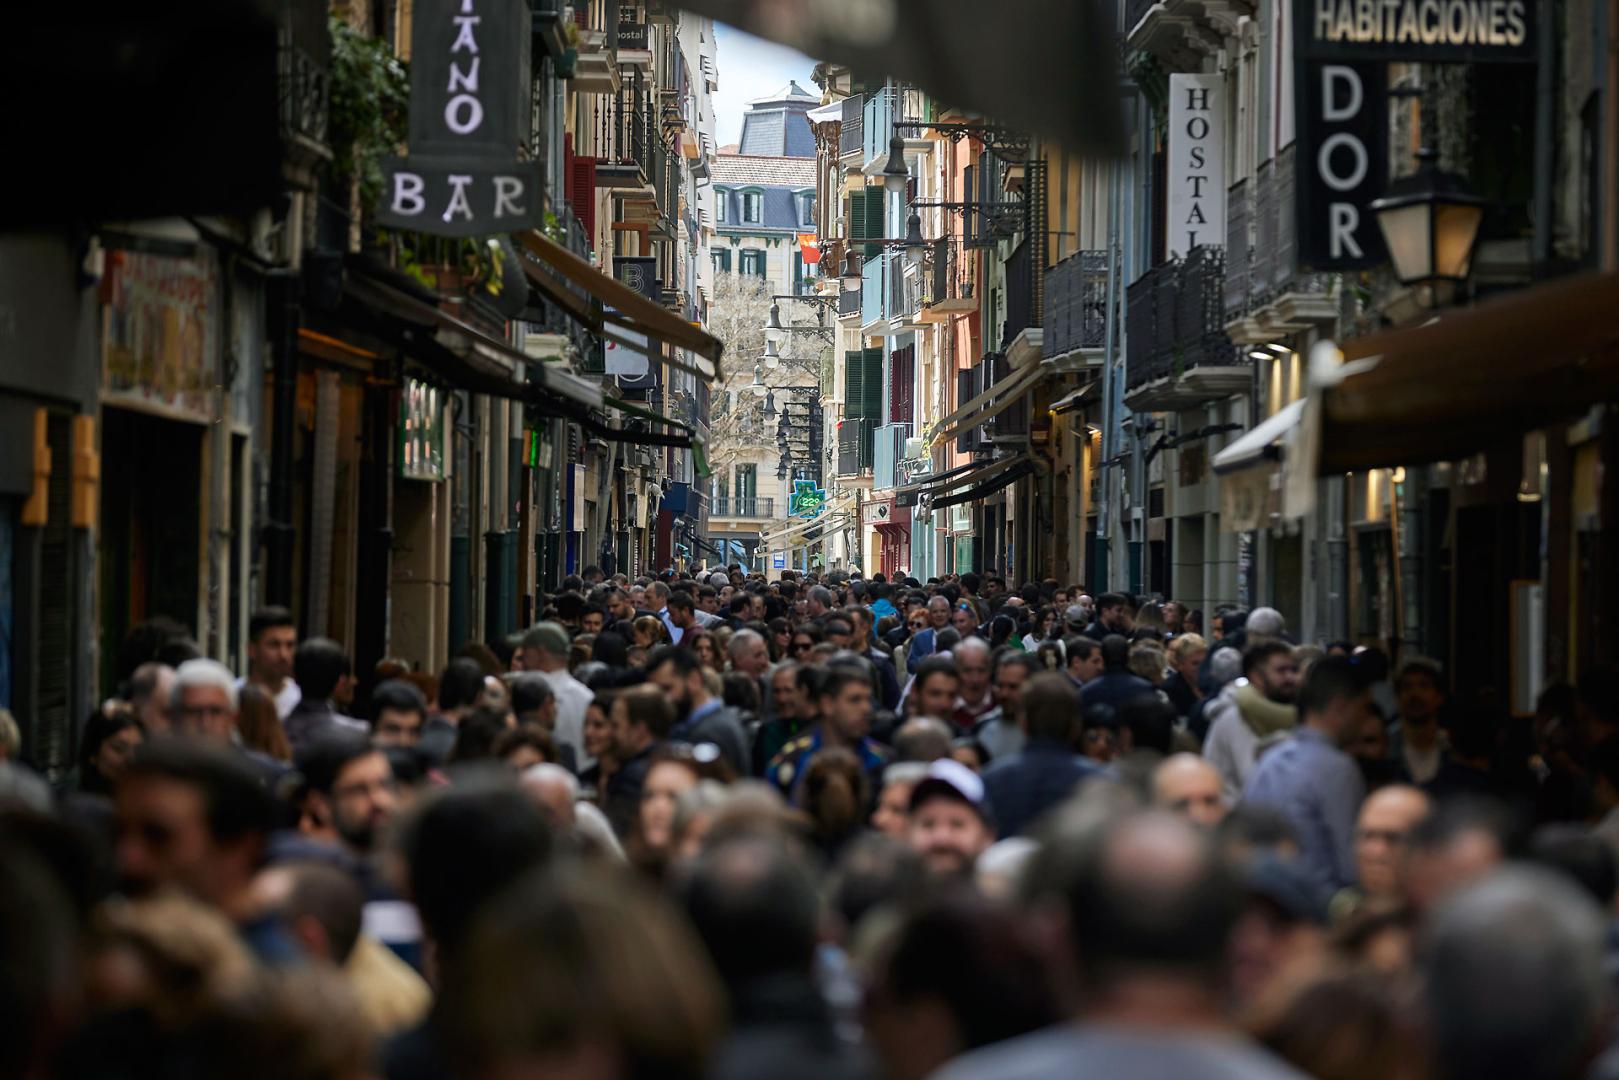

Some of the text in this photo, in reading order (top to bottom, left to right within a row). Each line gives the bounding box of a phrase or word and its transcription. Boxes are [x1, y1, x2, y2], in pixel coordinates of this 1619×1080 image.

[1314, 0, 1527, 46] HABITACIONES
[1318, 65, 1368, 259] DOR
[391, 172, 526, 223] BAR
